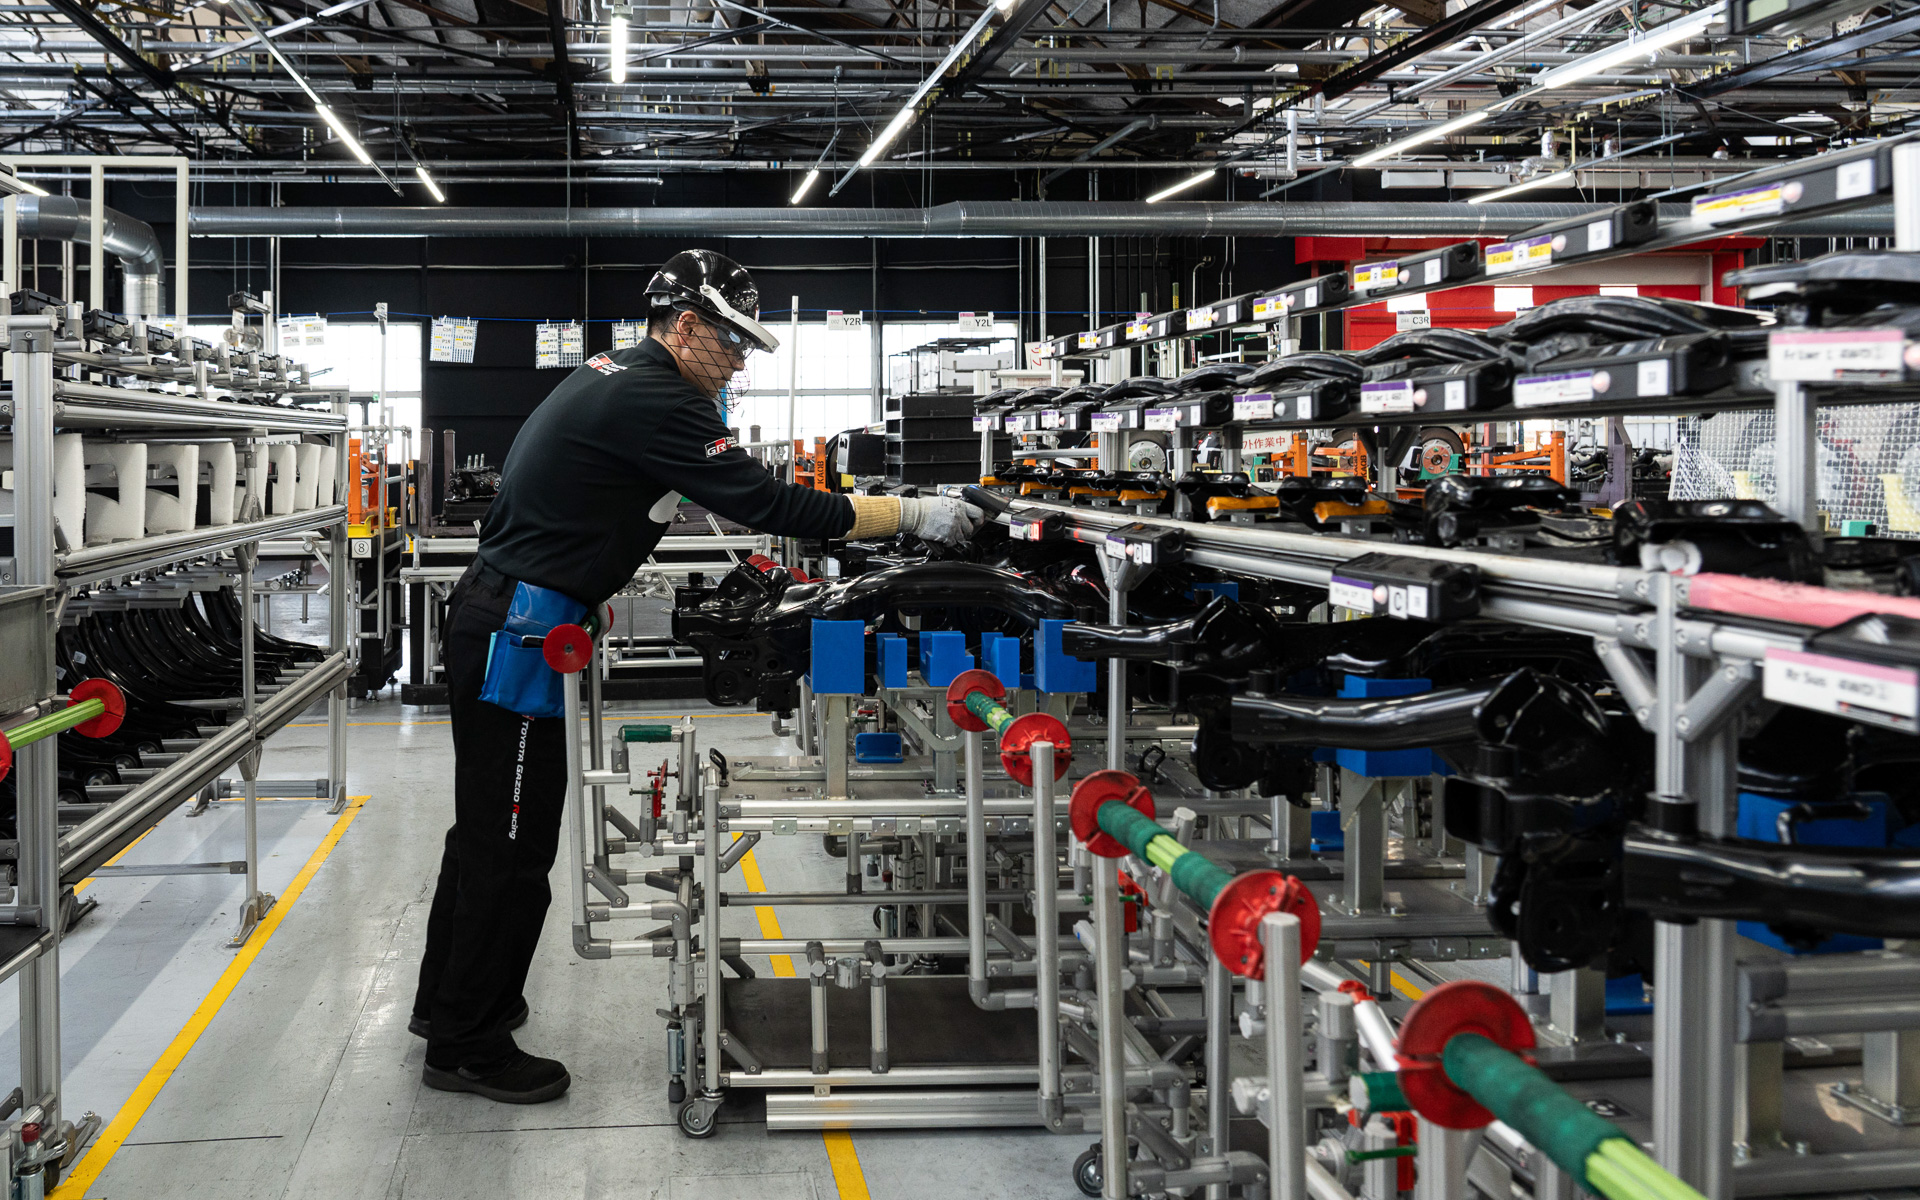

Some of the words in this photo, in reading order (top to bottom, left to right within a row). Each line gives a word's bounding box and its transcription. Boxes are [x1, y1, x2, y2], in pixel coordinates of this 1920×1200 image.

[843, 317, 862, 326] Y2R
[975, 319, 992, 327] Y2L
[1412, 316, 1430, 325] C3R
[708, 443, 727, 456] GR
[1394, 592, 1402, 611] C
[517, 721, 529, 762] TOYOTA
[513, 764, 524, 803] GAZOO
[508, 804, 520, 840] Racing
